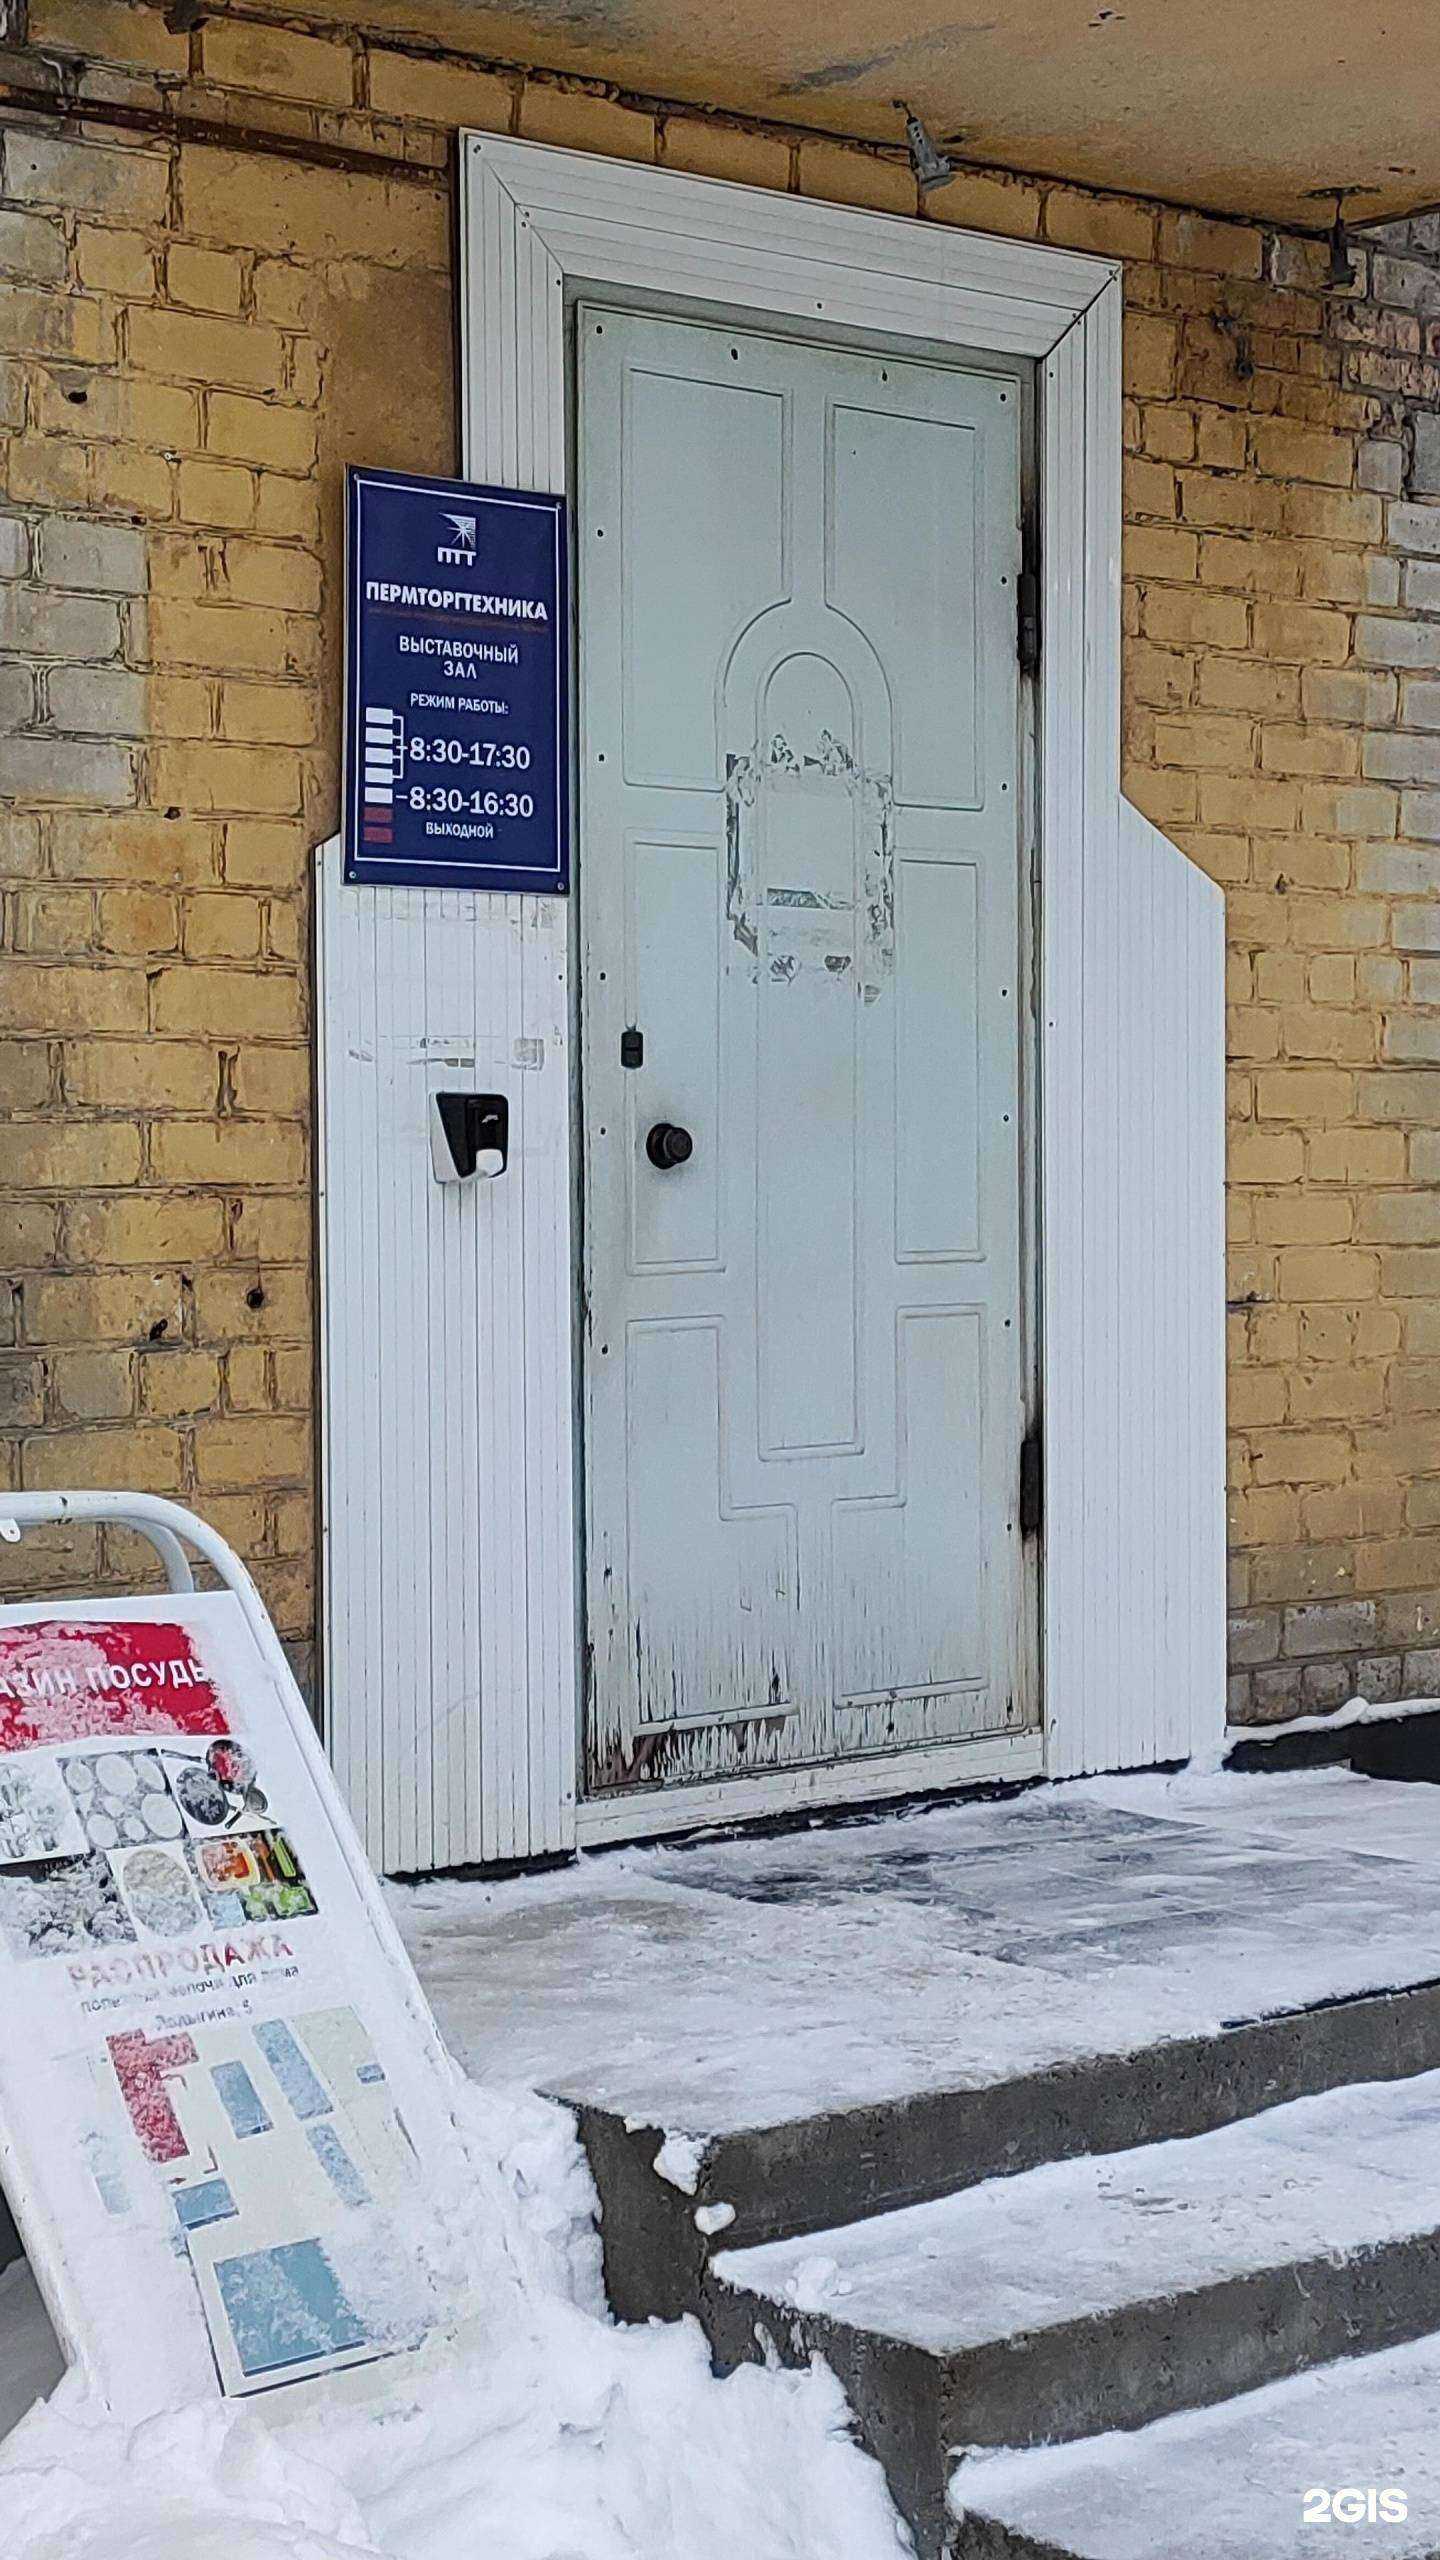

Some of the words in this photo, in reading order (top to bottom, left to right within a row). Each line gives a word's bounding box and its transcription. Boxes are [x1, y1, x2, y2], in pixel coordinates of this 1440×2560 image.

[437, 547, 477, 566] ПТТ
[366, 581, 548, 621] ПЕРМТОРГТЕХНИКА
[399, 635, 519, 665] ВЫСТАВОЧНЫЙ
[443, 660, 477, 679] ЗАЛ
[410, 692, 455, 710] РЕЖИМ
[458, 697, 509, 715] РАБОТЫ:
[425, 821, 494, 839] ВЫХОДНОЙ
